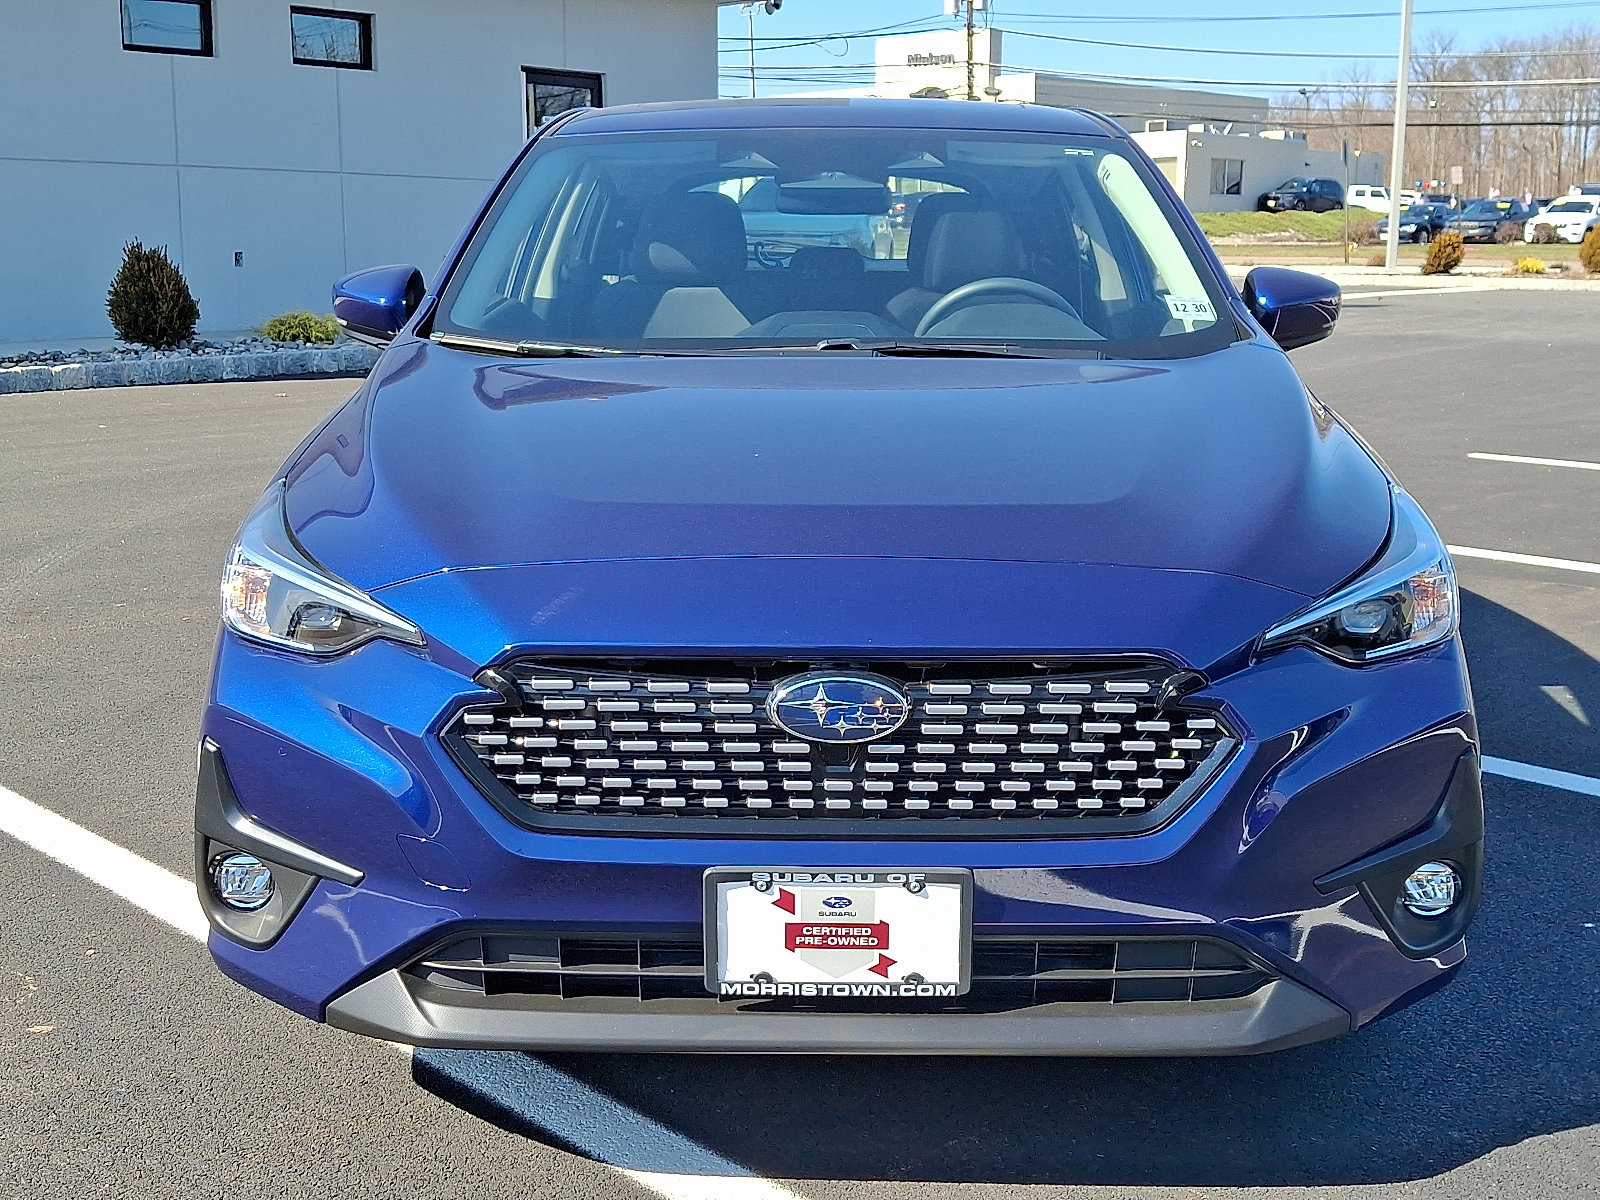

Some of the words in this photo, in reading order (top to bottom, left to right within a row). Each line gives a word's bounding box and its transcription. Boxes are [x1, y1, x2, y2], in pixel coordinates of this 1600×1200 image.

[1173, 303, 1189, 312] 12
[1191, 303, 1207, 312] 30
[751, 872, 875, 882] SUBARU
[886, 873, 926, 882] OF
[802, 926, 872, 936] CERTIFIED
[795, 936, 879, 946] PRE-OWNED
[720, 982, 957, 997] MORRISTOWN.COM
